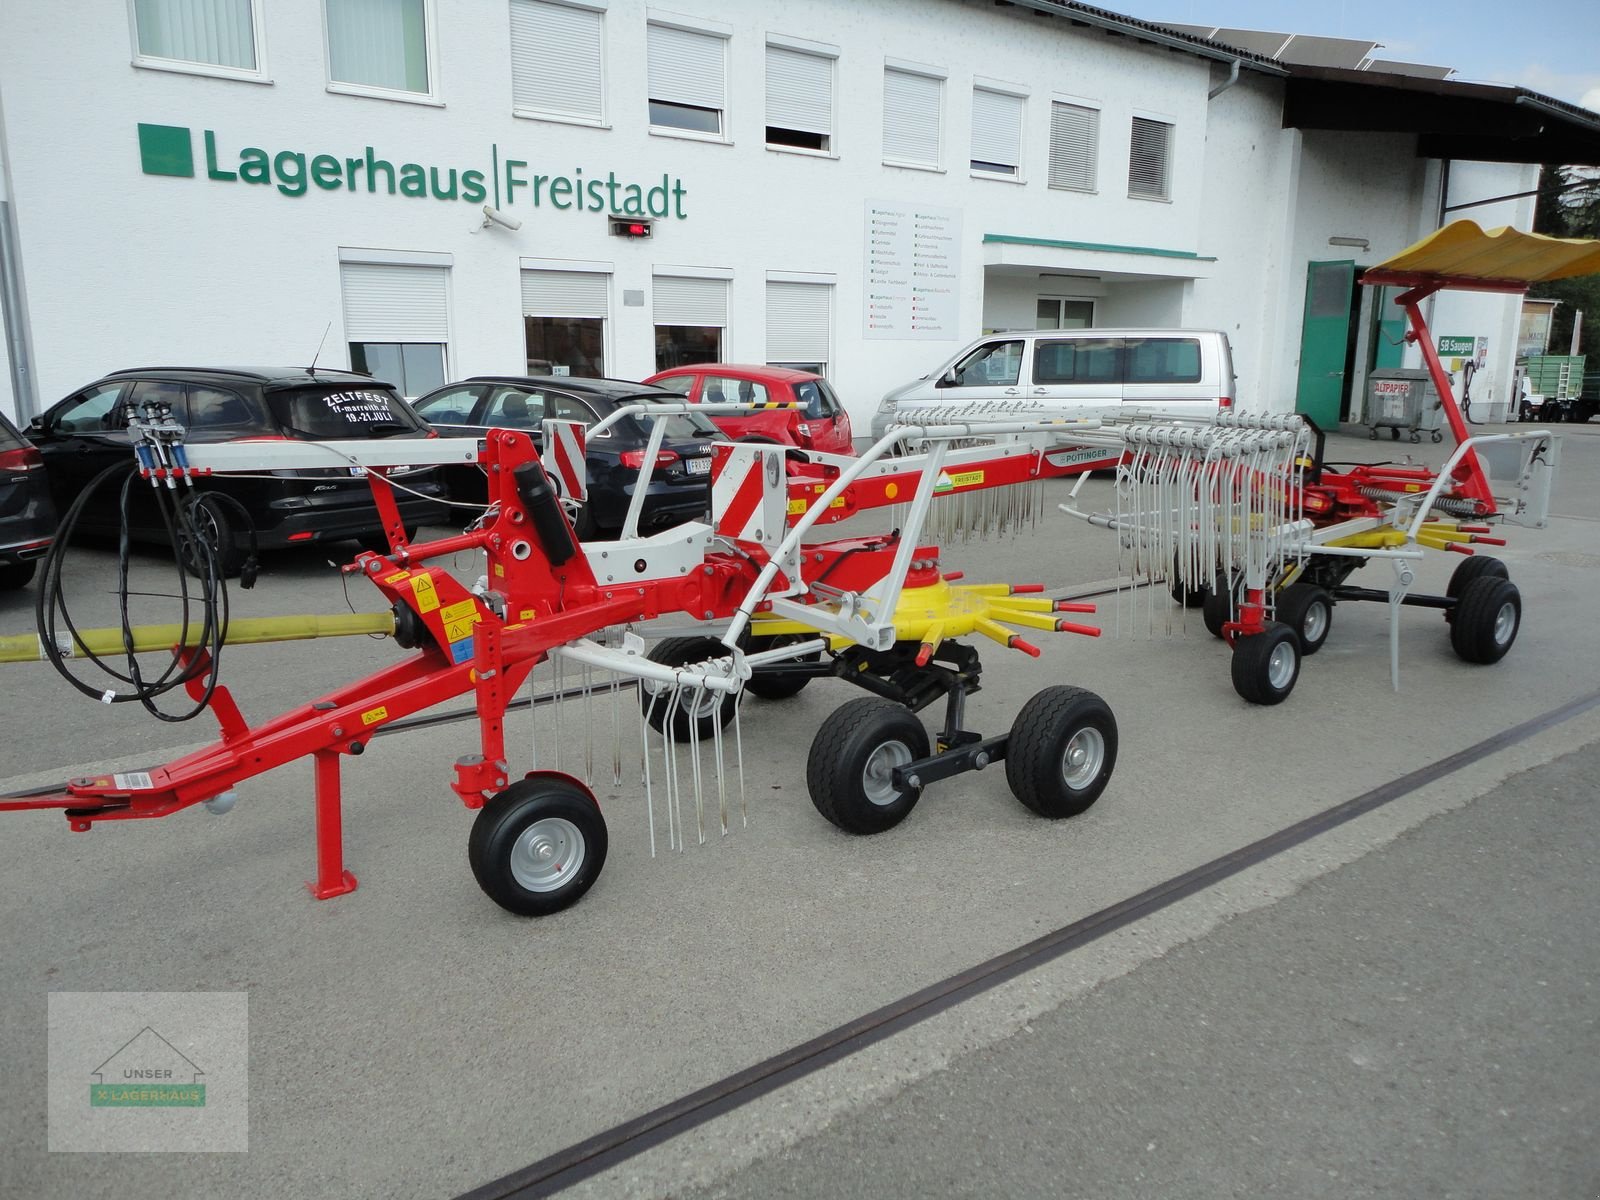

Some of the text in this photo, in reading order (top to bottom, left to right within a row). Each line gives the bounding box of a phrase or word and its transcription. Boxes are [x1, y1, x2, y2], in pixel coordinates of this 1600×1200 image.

[204, 129, 688, 220] Lagerhaus Freistadt
[1440, 339, 1450, 352] SB
[1375, 383, 1409, 394] ALTPAPIER
[322, 391, 389, 407] ZELTFEST
